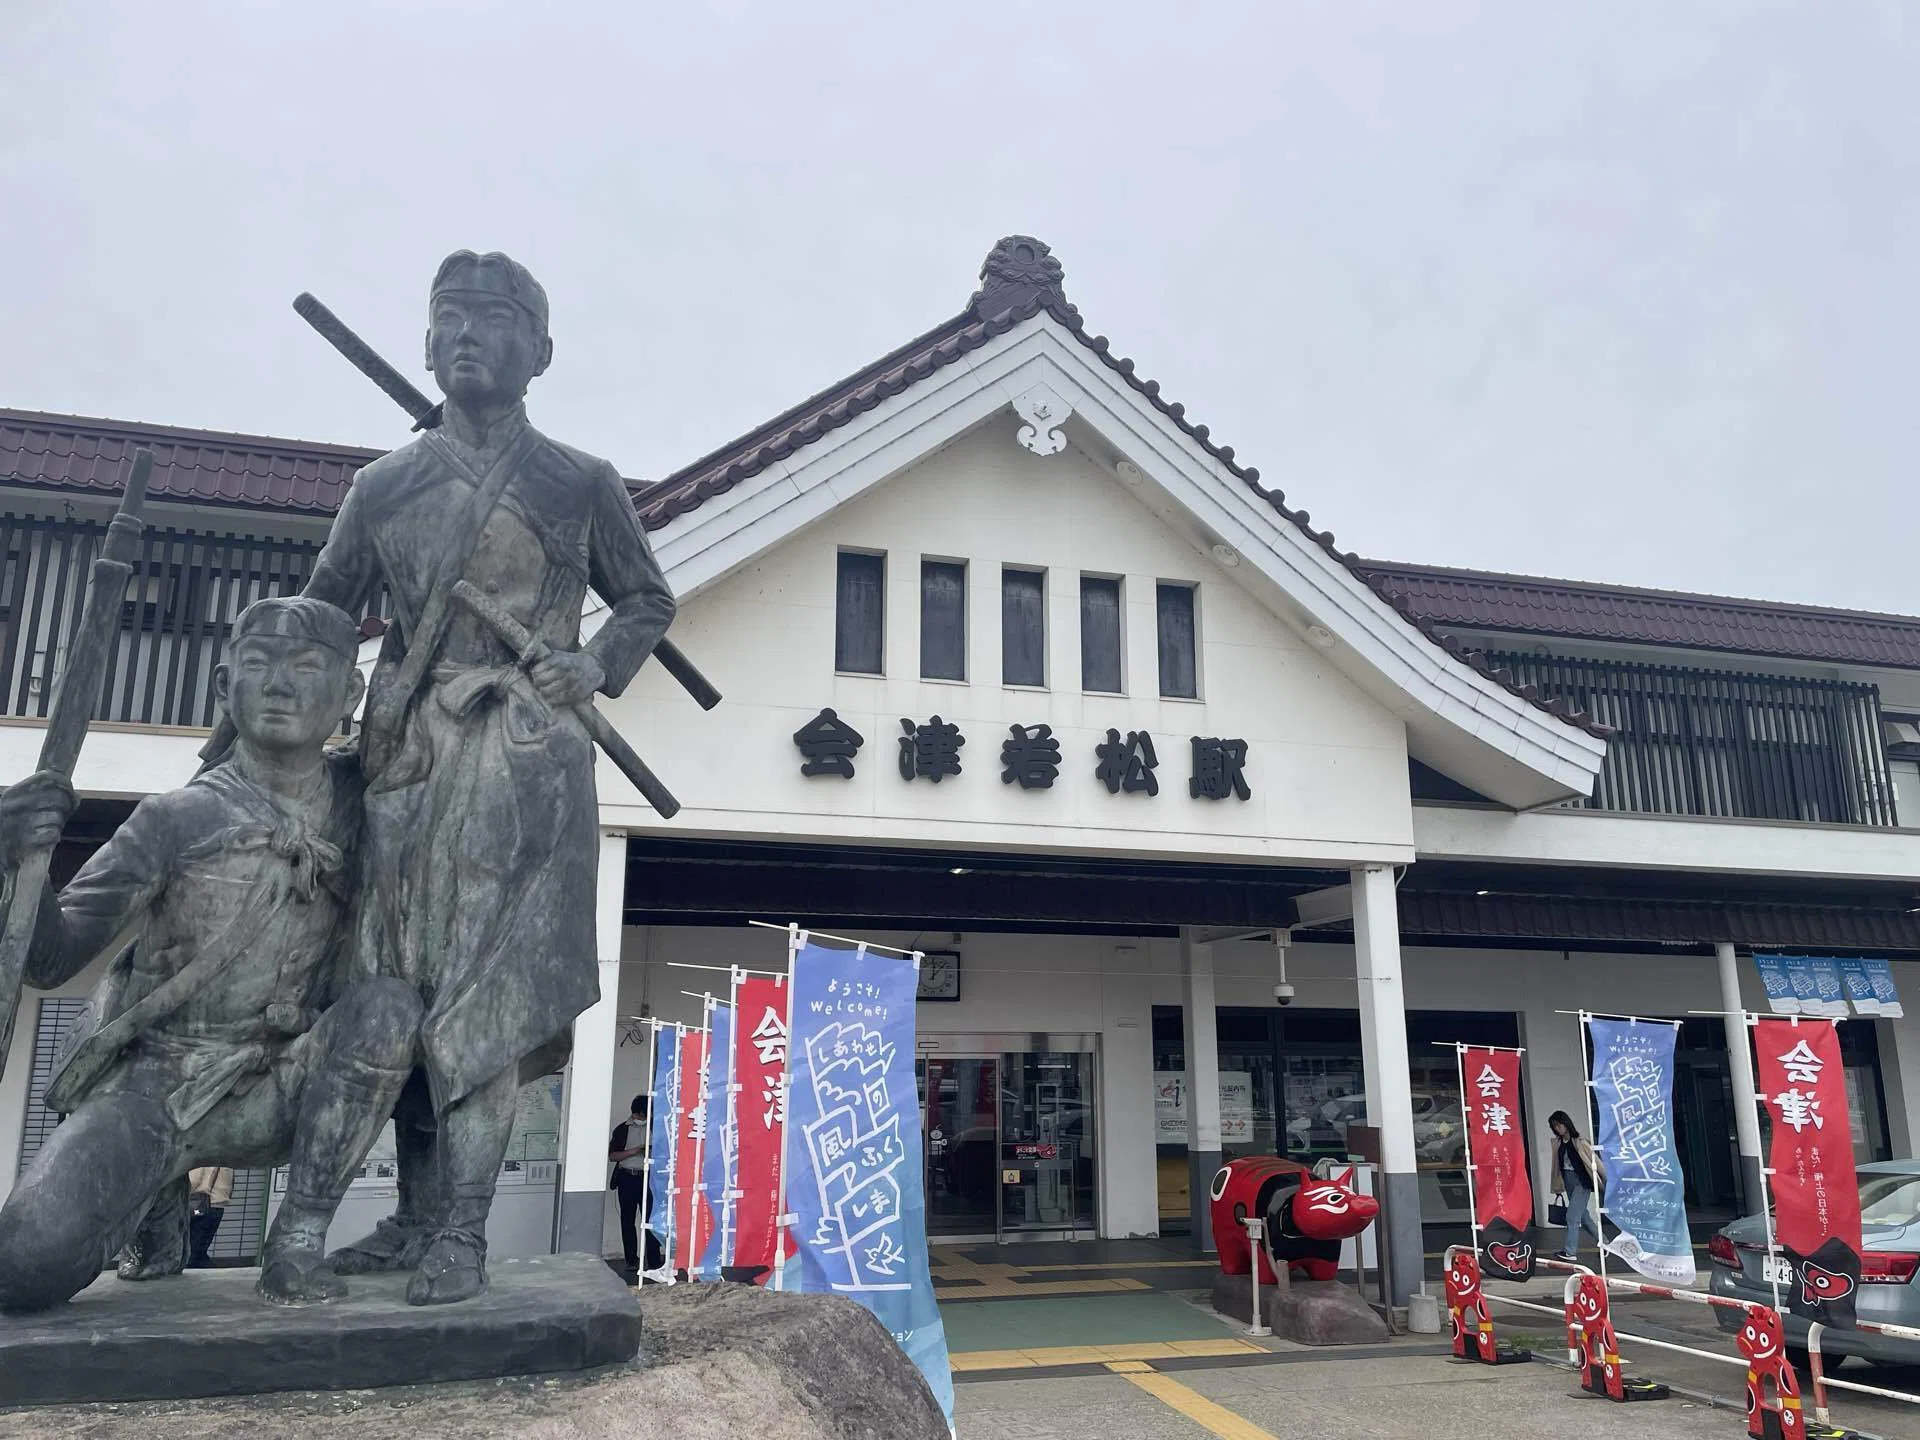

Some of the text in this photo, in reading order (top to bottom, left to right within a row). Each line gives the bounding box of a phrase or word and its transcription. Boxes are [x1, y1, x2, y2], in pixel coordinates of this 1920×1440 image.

[793, 707, 1252, 801] 会津若松駅
[811, 1000, 887, 1020] Welcome!
[819, 1039, 877, 1064] しあわせ
[1476, 1064, 1511, 1136] 会津
[819, 1126, 851, 1167] 風
